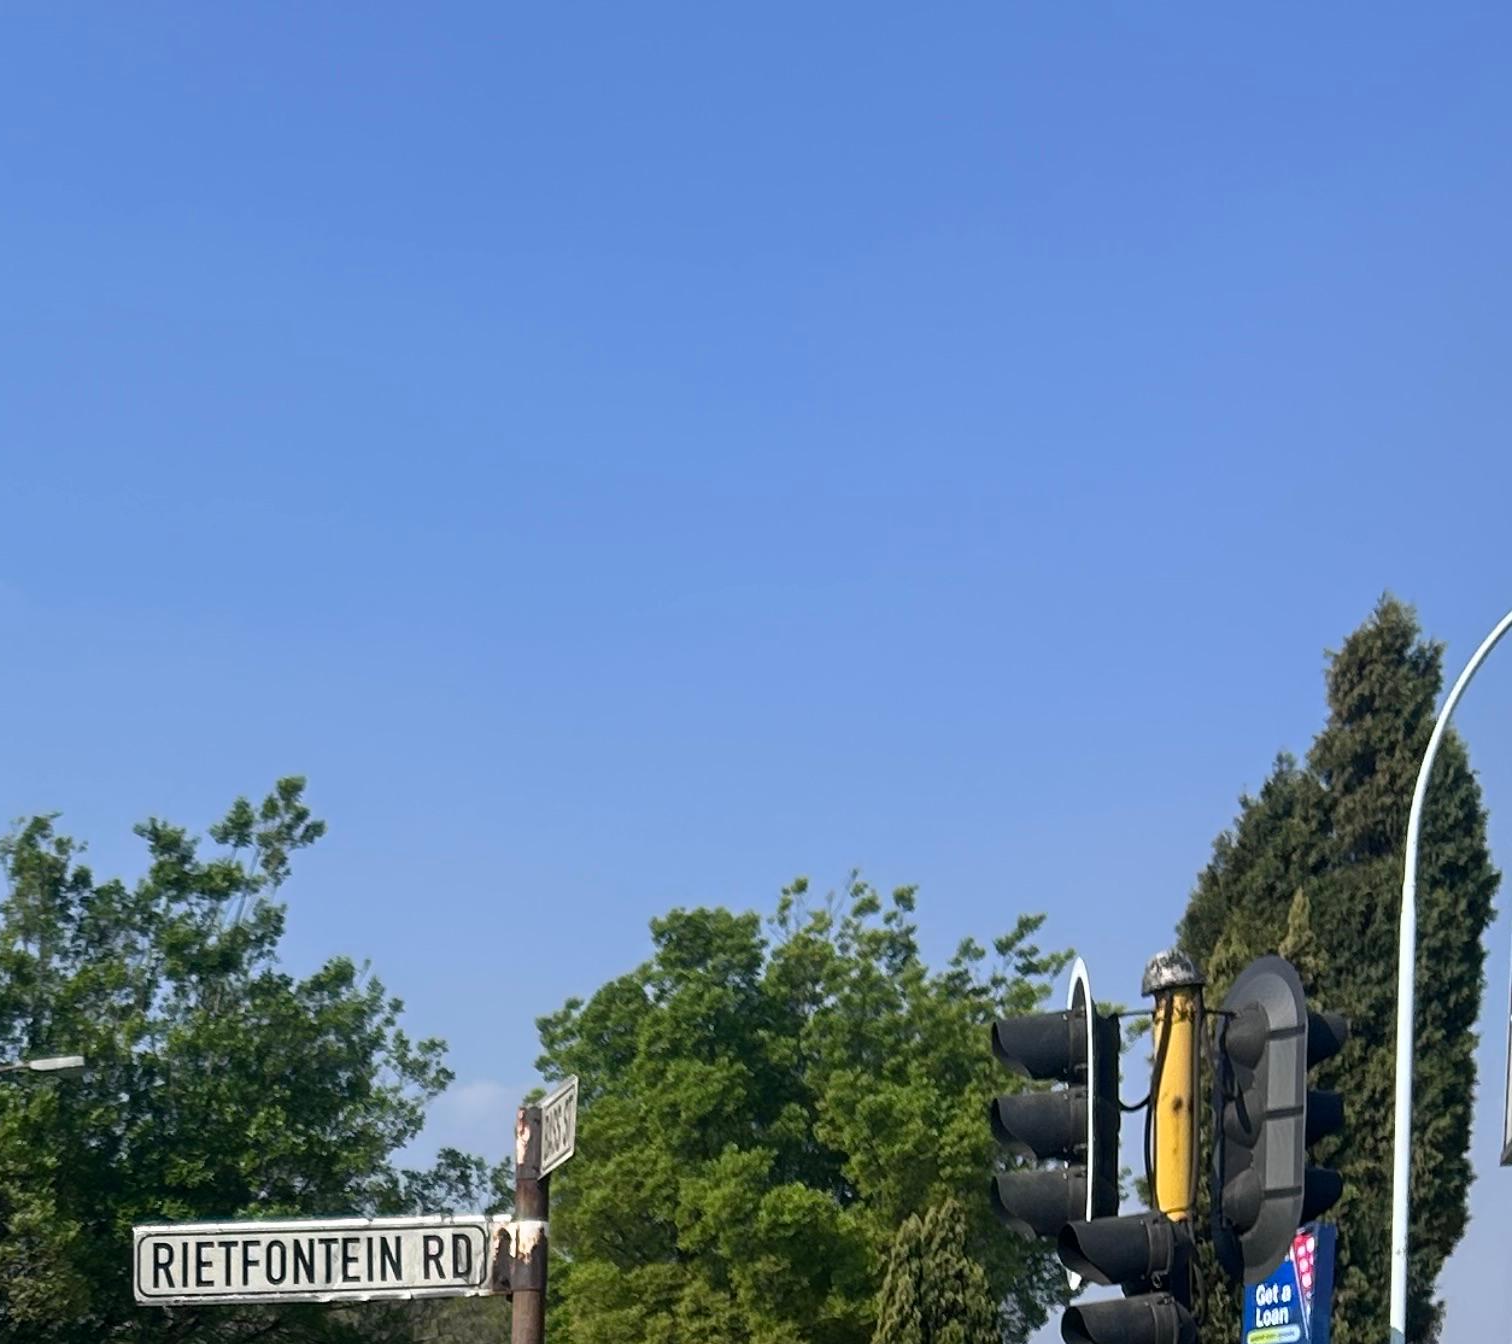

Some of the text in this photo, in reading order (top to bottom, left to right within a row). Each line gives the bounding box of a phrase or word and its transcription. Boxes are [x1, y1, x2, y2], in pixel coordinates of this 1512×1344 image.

[152, 1233, 473, 1288] RIETFONTEIN RD
[1256, 1283, 1292, 1306] Get a
[1256, 1306, 1289, 1328] Loan
